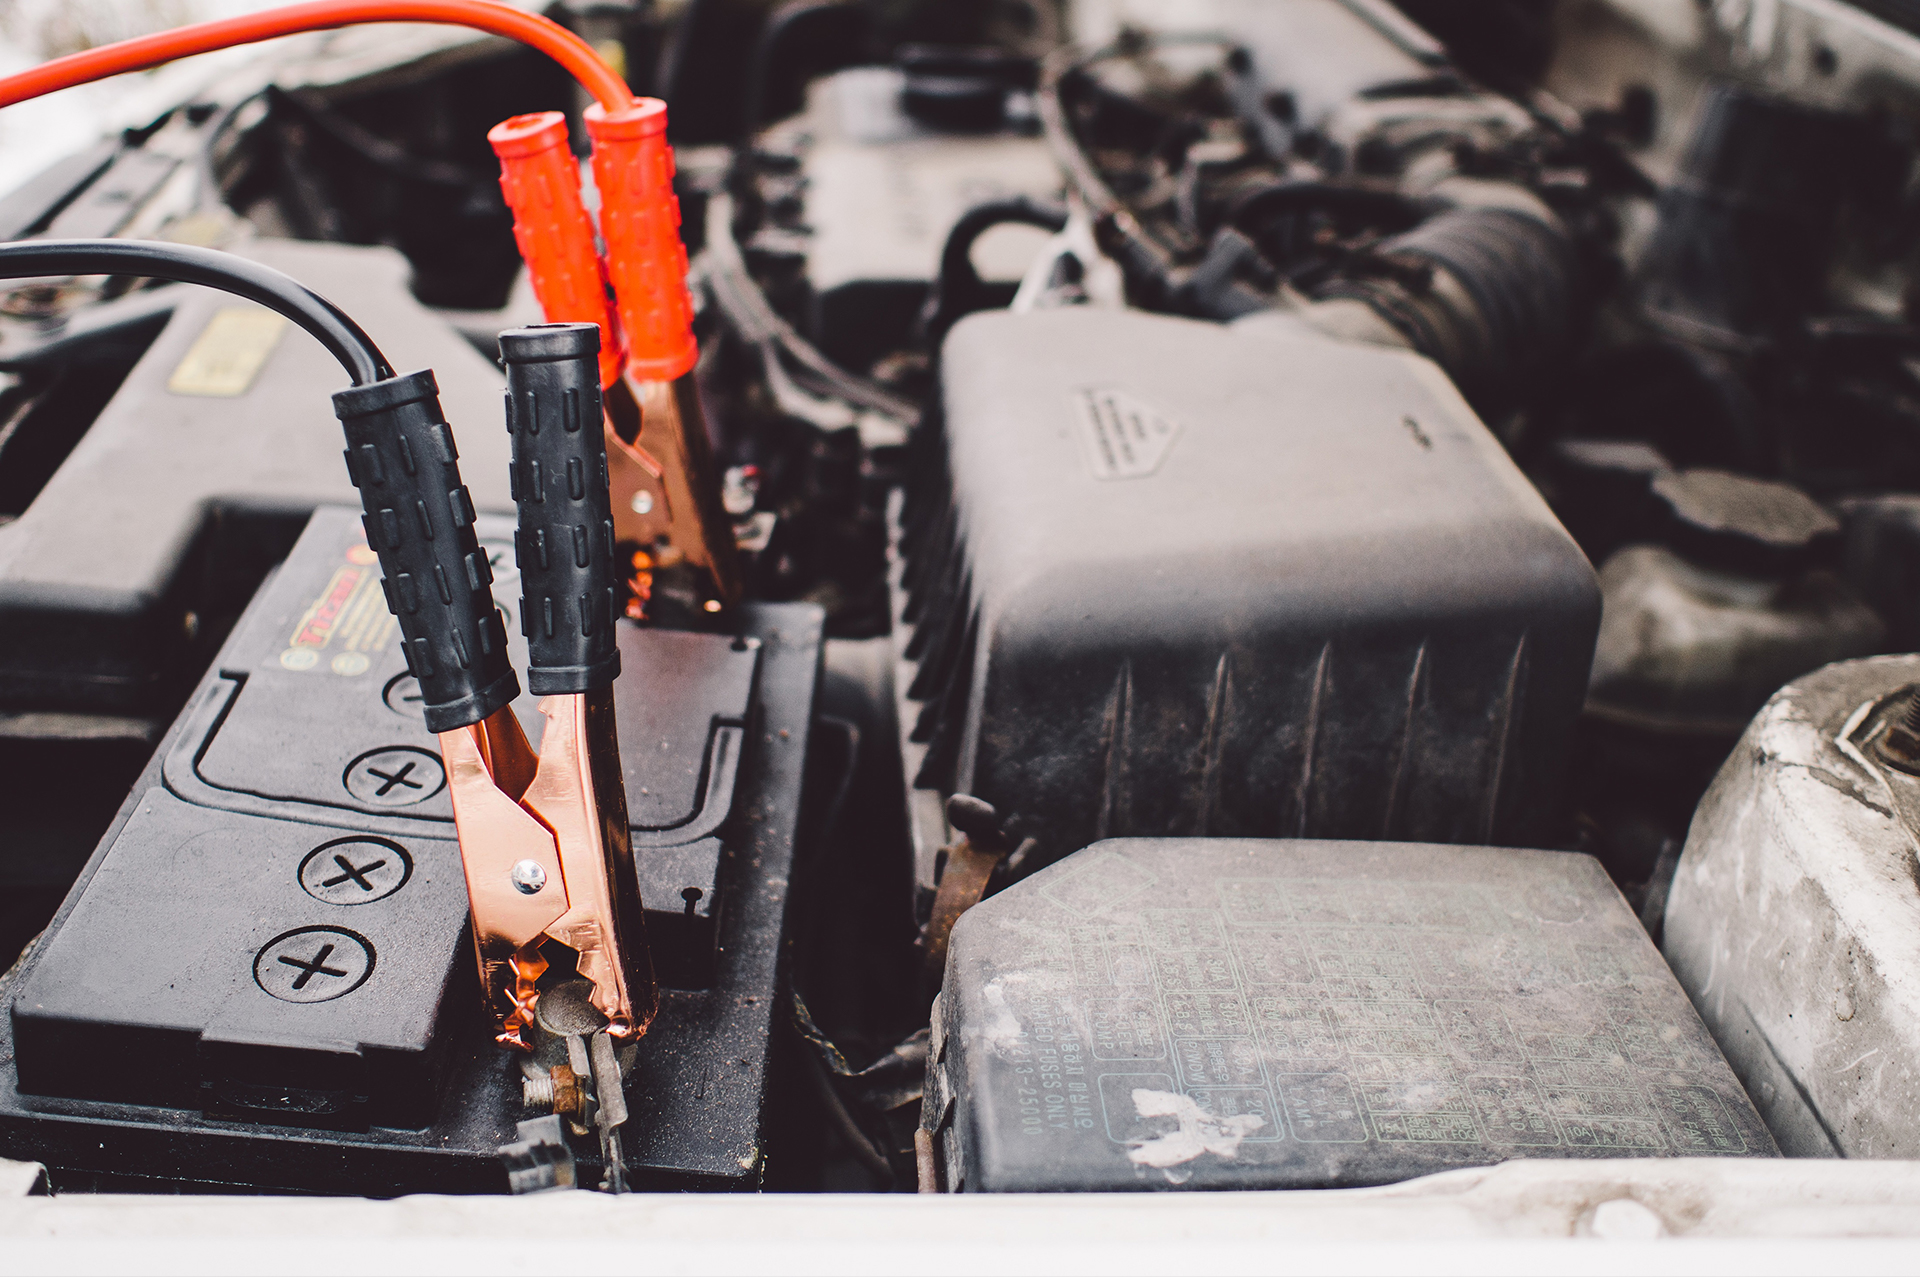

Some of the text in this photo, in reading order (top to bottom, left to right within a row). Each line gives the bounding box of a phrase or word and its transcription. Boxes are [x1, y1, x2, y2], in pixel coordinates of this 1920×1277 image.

[1205, 959, 1230, 981] 30A
[1245, 939, 1269, 971] START
[1025, 968, 1055, 1042] GNATED
[1218, 1002, 1242, 1026] 30A
[1093, 1012, 1115, 1049] PUMP
[1113, 1013, 1133, 1047] FUEL
[1037, 1048, 1062, 1088] FUSES
[1059, 1032, 1085, 1074] 사용하지
[1182, 1041, 1206, 1082] P/WDW
[1231, 1048, 1255, 1075] 30A
[1288, 1088, 1314, 1127] LAMP
[1308, 1087, 1335, 1127] TAIL
[1494, 1088, 1527, 1130] COND
[1663, 1089, 1690, 1112] RAD
[1680, 1121, 1707, 1145] FAN
[1377, 1122, 1403, 1132] 15A
[1409, 1128, 1477, 1139] FRONT FOG
[1566, 1126, 1591, 1136] 10A
[1600, 1134, 1660, 1145] A/CON
